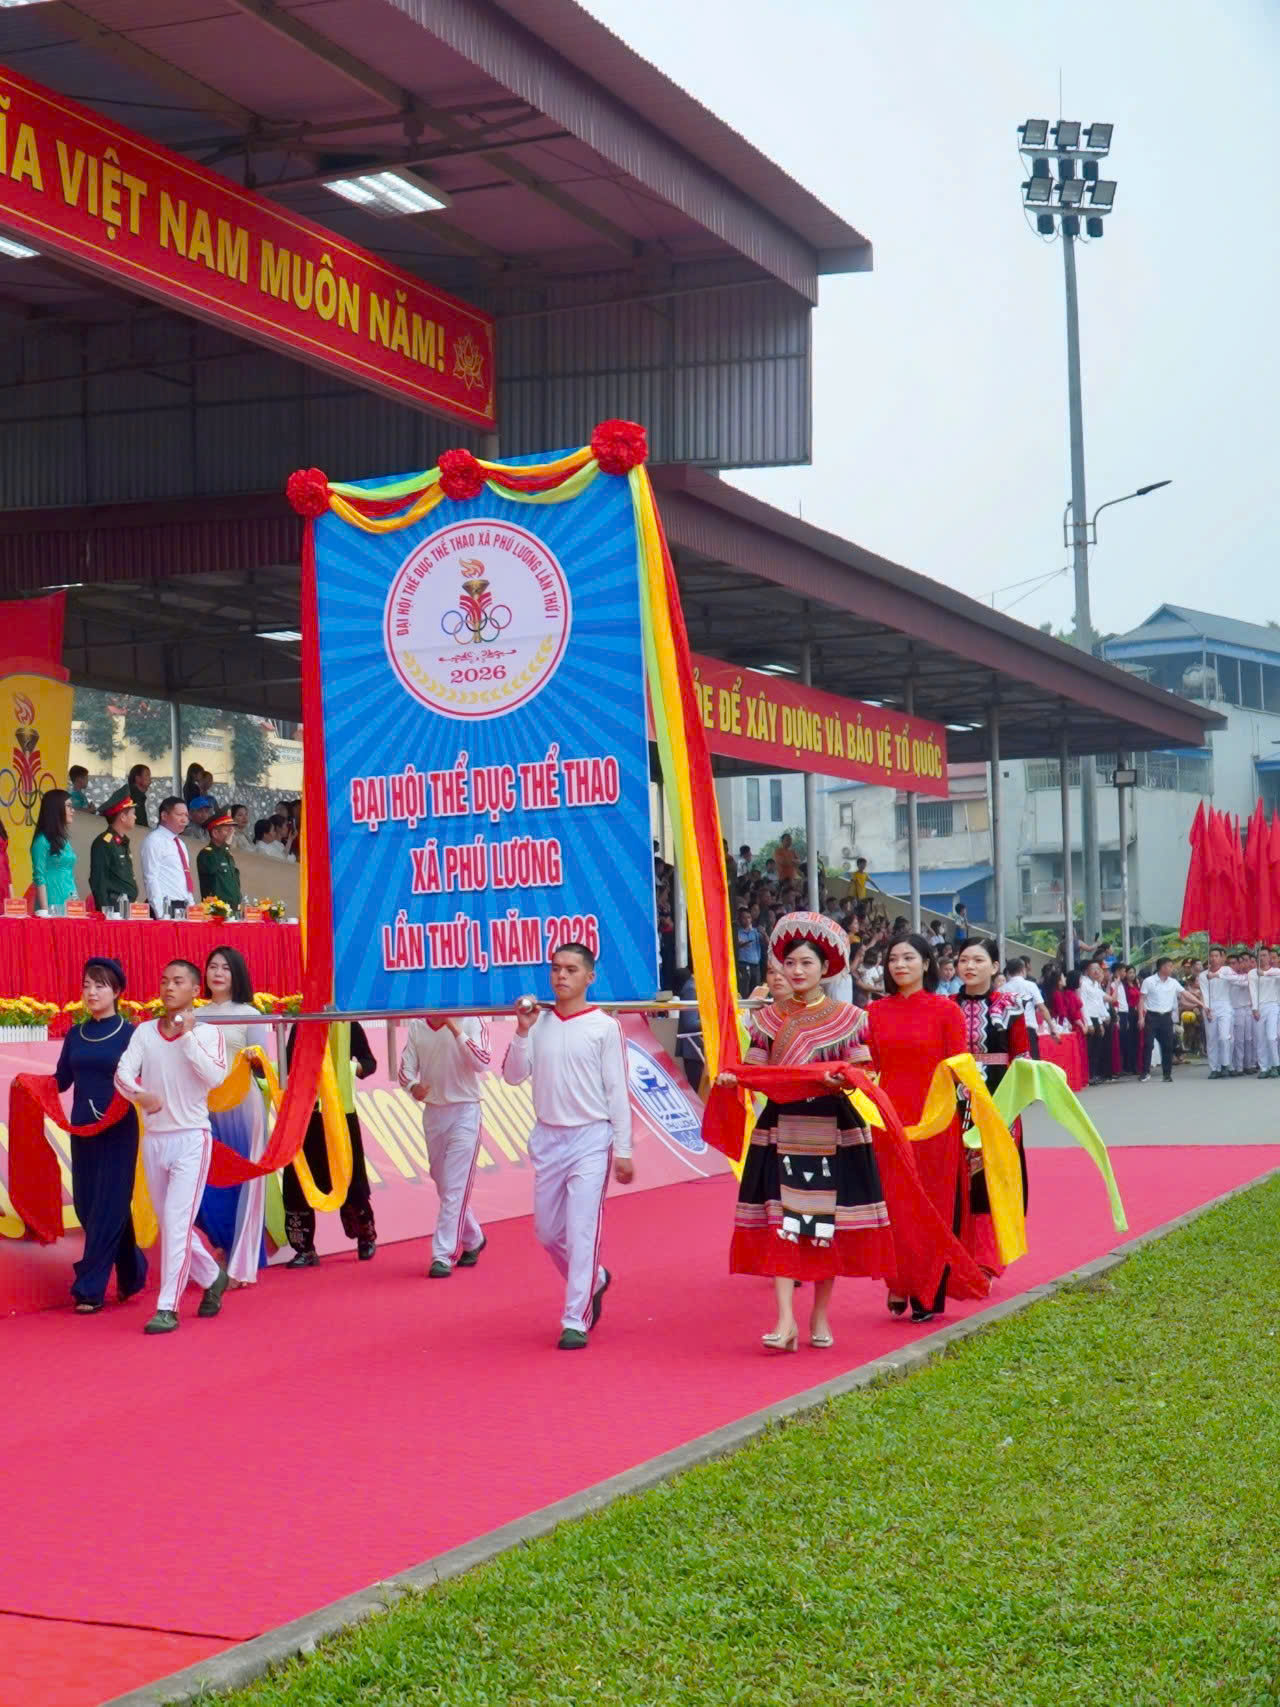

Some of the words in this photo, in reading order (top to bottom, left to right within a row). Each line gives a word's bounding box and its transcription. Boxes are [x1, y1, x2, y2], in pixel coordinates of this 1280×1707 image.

[56, 139, 147, 241] VIỆT
[160, 191, 249, 284] NAM
[260, 240, 360, 334] MUÔN
[370, 292, 446, 374] NĂM!
[450, 533, 475, 552] THAO
[450, 665, 507, 684] 2026
[719, 675, 742, 735] ĐỂ
[746, 690, 778, 742] XÂY
[782, 703, 822, 757] DỰNG
[825, 711, 845, 757] VÀ
[846, 712, 872, 765] BẢO
[877, 726, 893, 777] VỆ
[894, 722, 910, 771] TỔ
[912, 730, 942, 779] QUỐC
[352, 779, 387, 831] ĐẠI
[391, 765, 424, 826] HỘI
[429, 752, 468, 816] THỂ
[473, 766, 515, 820] DỤC
[520, 744, 559, 808] THỂ
[564, 757, 620, 804] THAO
[411, 838, 441, 893] XÃ
[445, 834, 487, 890] PHÚ
[491, 837, 563, 886] LƯƠNG
[383, 910, 425, 970] LẦN
[428, 913, 470, 967] THỨ
[490, 911, 542, 964] NĂM
[547, 916, 599, 961] 2026
